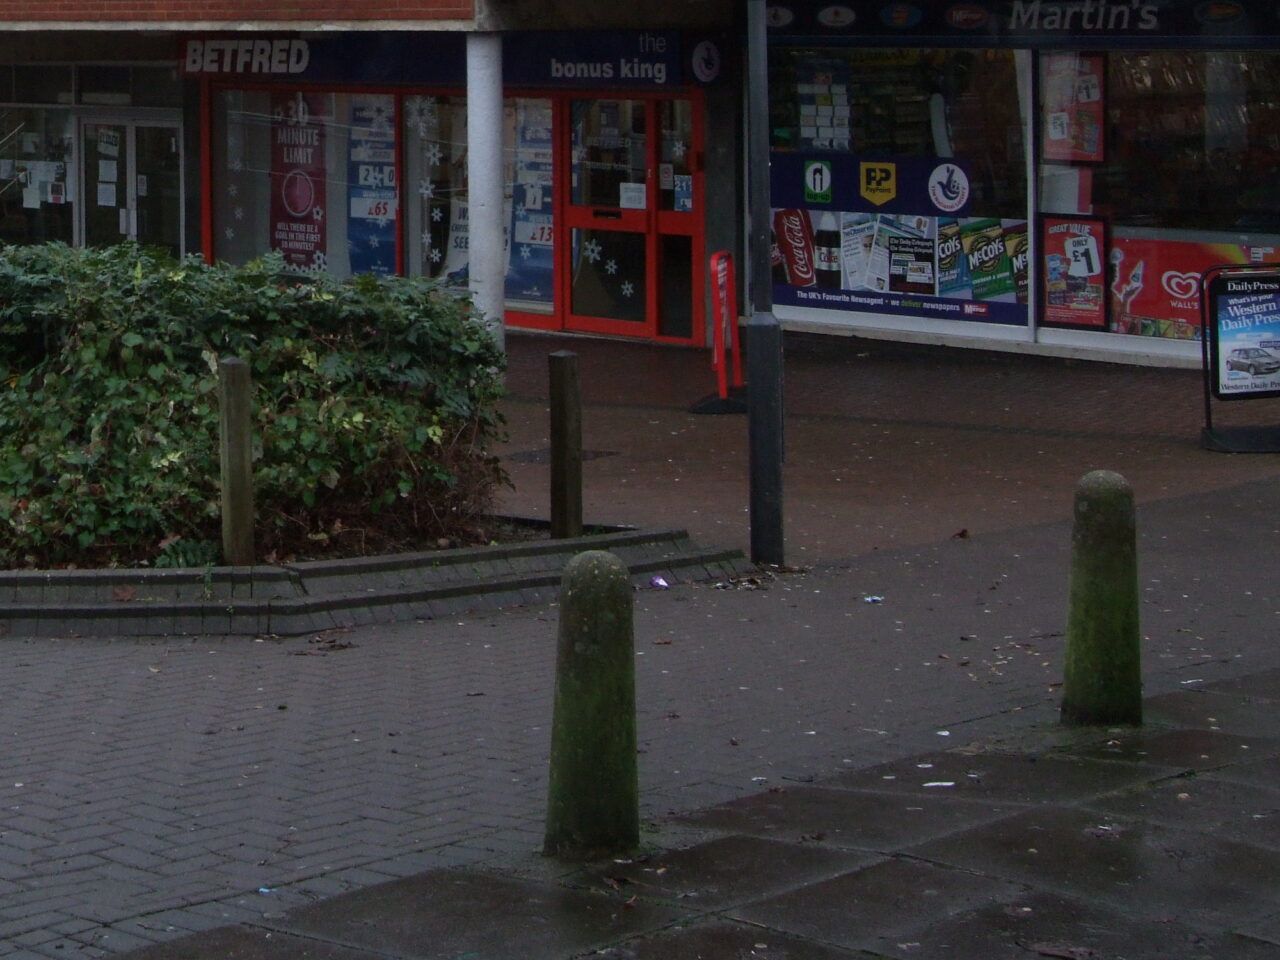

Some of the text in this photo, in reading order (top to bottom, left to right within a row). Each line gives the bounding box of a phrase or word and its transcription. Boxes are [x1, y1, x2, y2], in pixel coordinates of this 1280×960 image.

[639, 31, 667, 53] the
[186, 39, 310, 73] BETFRED
[550, 58, 667, 84] bonus king
[277, 127, 319, 146] MINUTE
[283, 147, 314, 164] LIMIT
[1069, 224, 1092, 236] VALUE
[1072, 239, 1088, 247] ONLY
[1072, 248, 1094, 274] £1
[797, 290, 807, 298] The
[808, 291, 821, 300] UK's
[822, 292, 850, 302] Favourite
[851, 294, 884, 305] Newsagent
[923, 302, 960, 311] newspapers
[1169, 300, 1199, 310] WALL'S
[1227, 302, 1277, 318] Western
[1221, 316, 1253, 331] Daily
